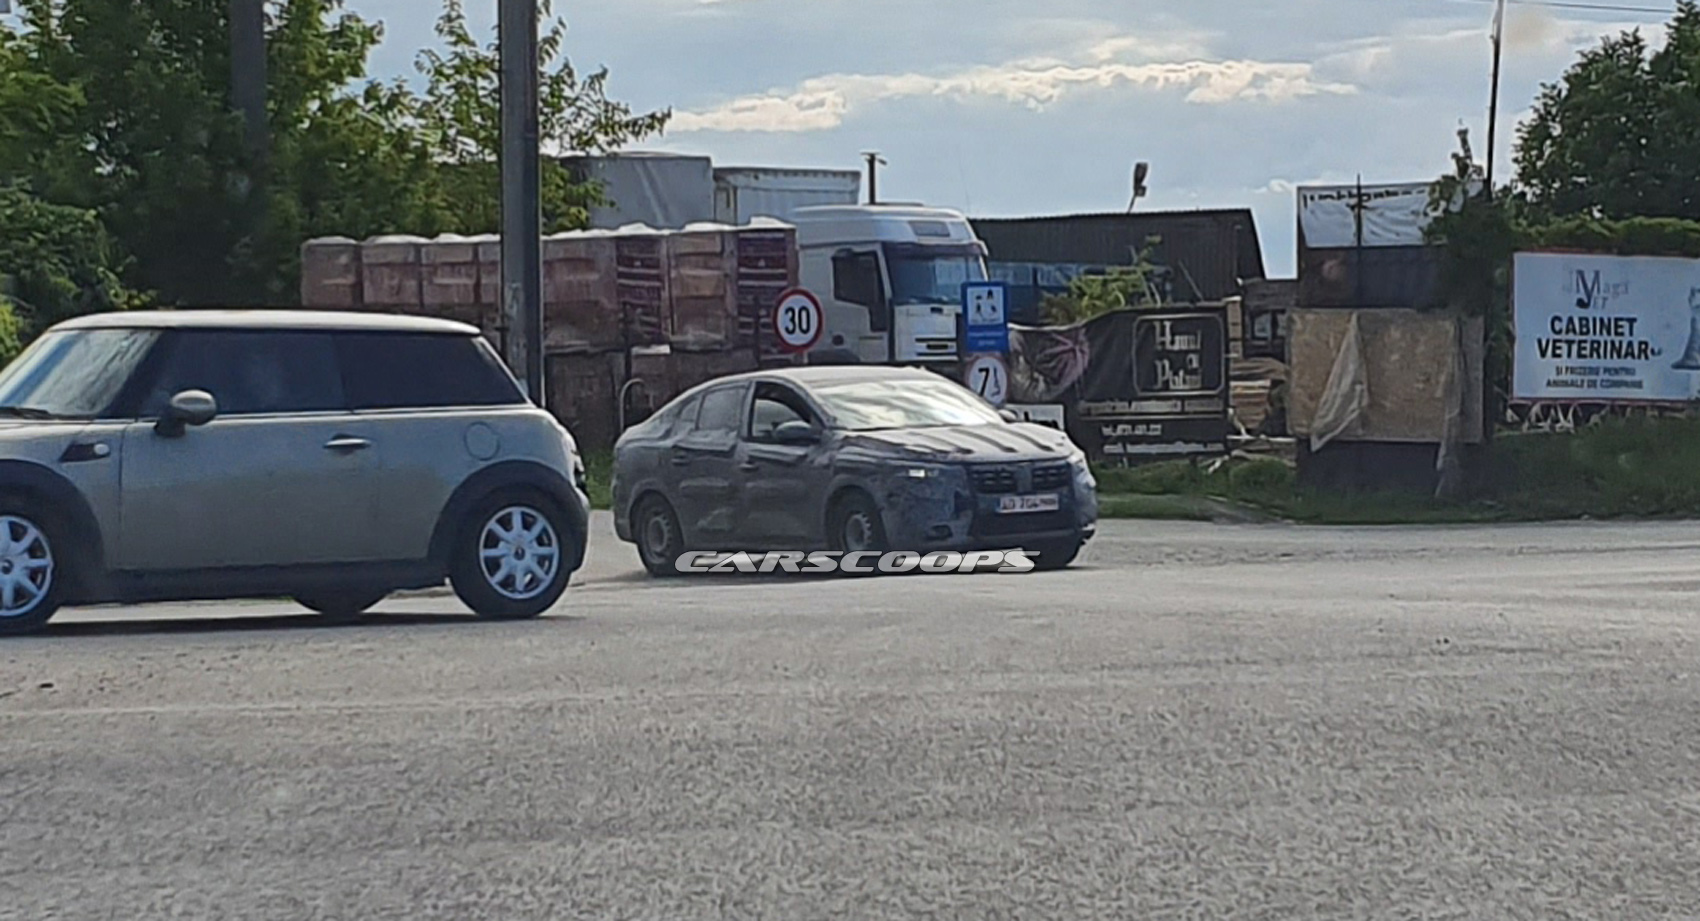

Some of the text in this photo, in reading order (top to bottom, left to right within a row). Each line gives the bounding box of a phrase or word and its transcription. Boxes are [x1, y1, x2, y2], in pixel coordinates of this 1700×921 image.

[785, 306, 811, 334] 30
[1550, 315, 1637, 337] CABINET
[1537, 338, 1649, 360] VETERINAR
